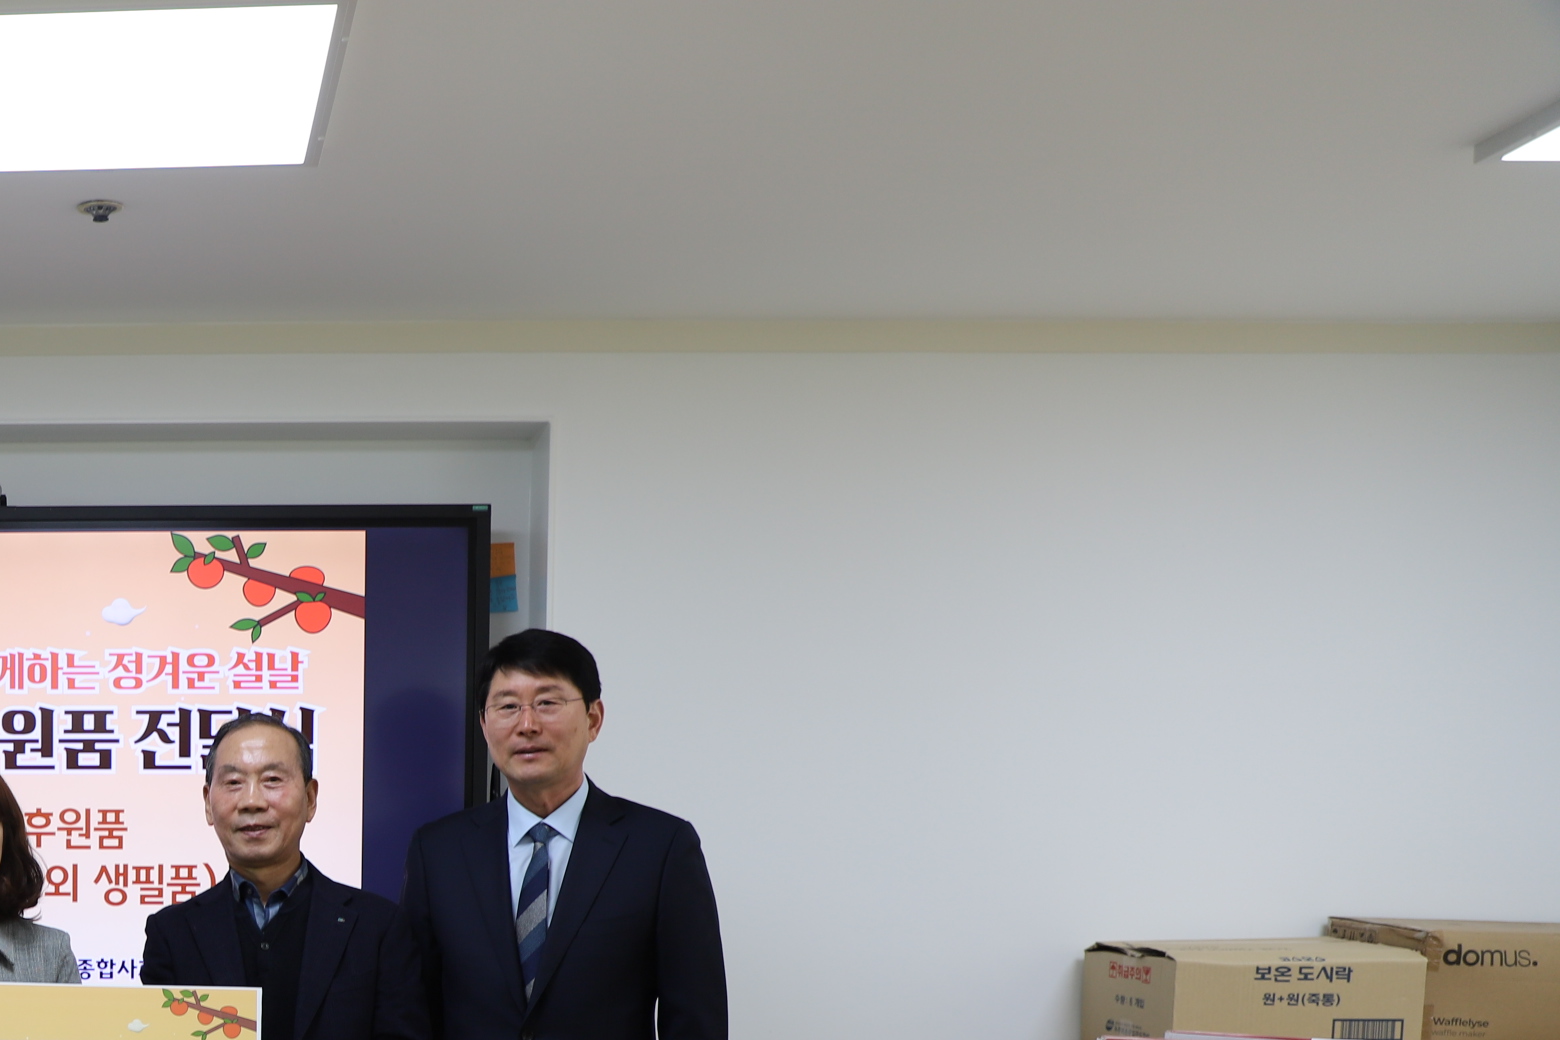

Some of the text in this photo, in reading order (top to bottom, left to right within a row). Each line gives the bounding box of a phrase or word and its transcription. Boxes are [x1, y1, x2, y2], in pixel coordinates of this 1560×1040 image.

[108, 652, 219, 690] 정겨운
[232, 651, 303, 690] 설날
[24, 808, 128, 849] 후원품
[45, 864, 78, 902] 외
[1254, 966, 1353, 983] 보온 도시락
[1262, 992, 1340, 1007] 원+원(죽통)
[1433, 1016, 1489, 1031] Wafflelyse
